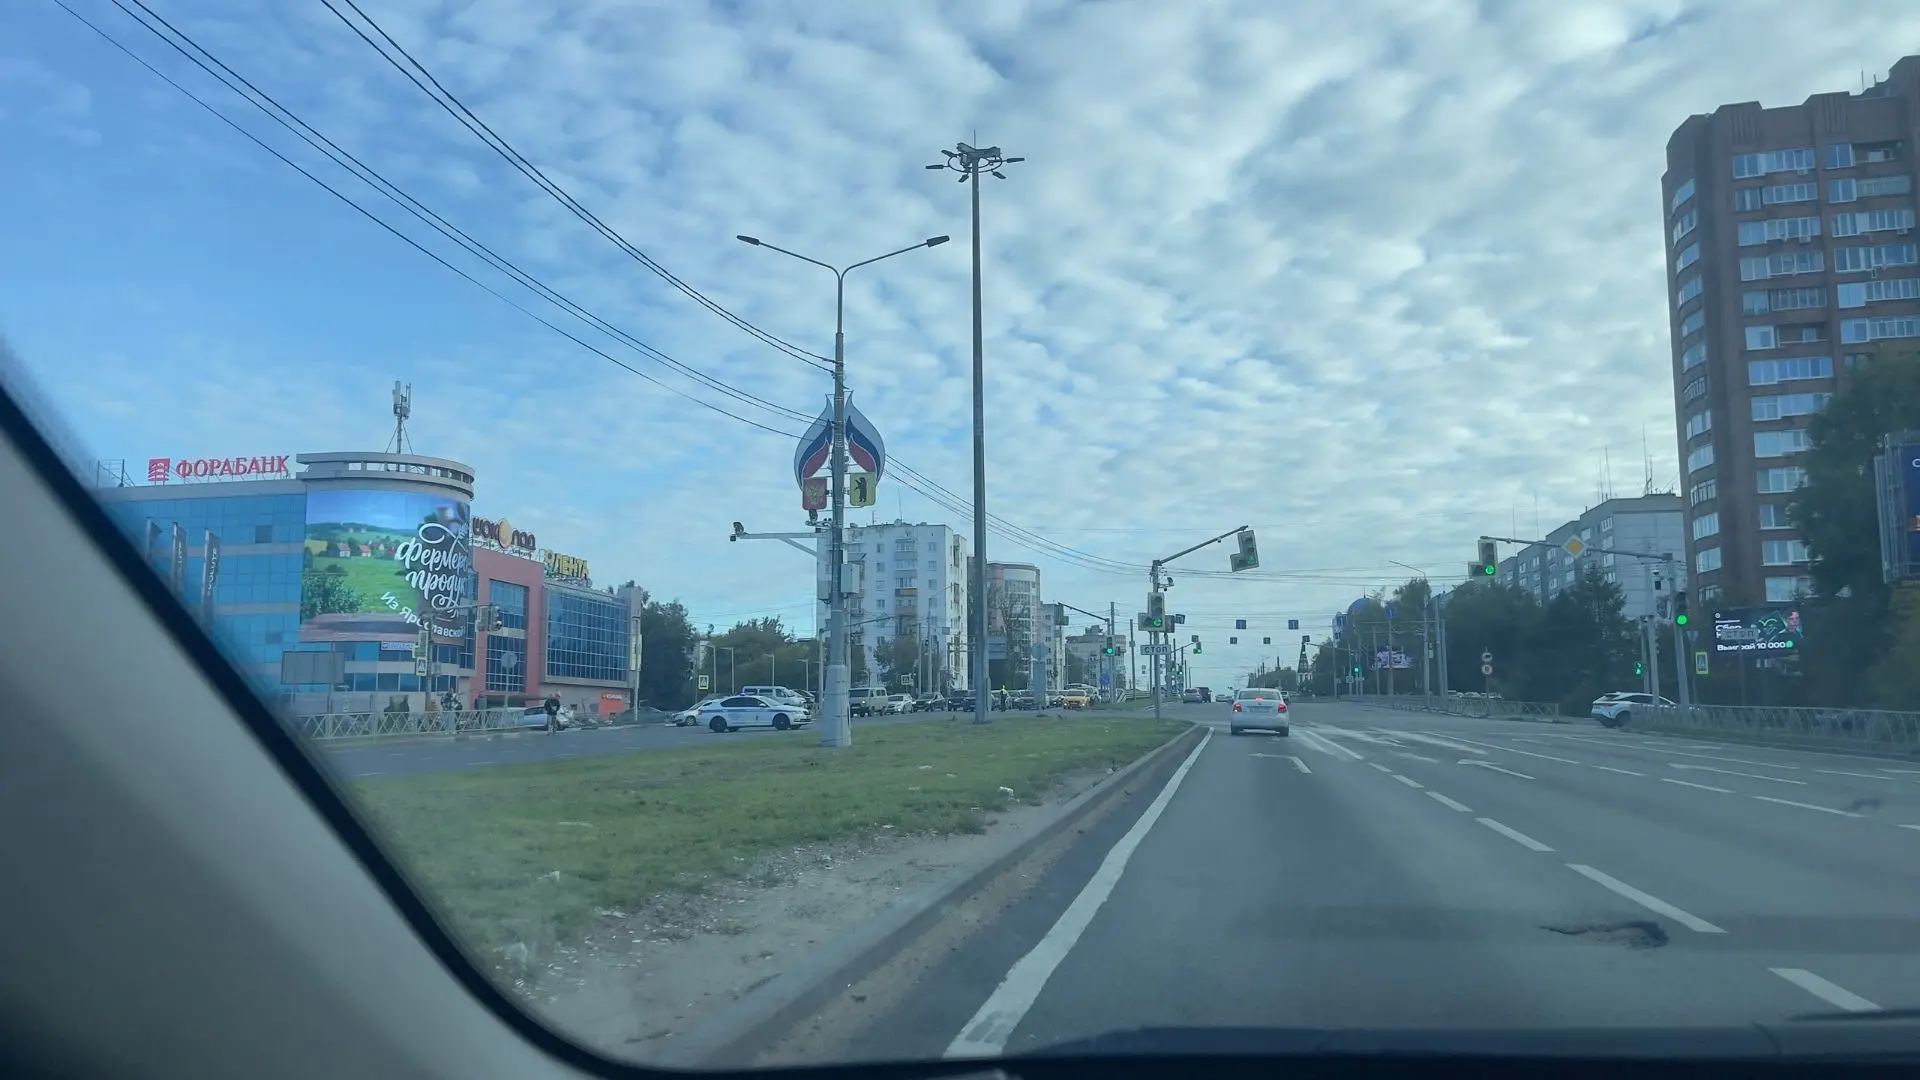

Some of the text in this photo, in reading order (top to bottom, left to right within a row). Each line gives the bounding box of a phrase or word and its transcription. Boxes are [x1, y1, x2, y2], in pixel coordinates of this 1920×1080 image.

[176, 456, 289, 478] ФОРАБАНК
[554, 553, 588, 579] ЛЕНТА
[380, 591, 399, 610] Из
